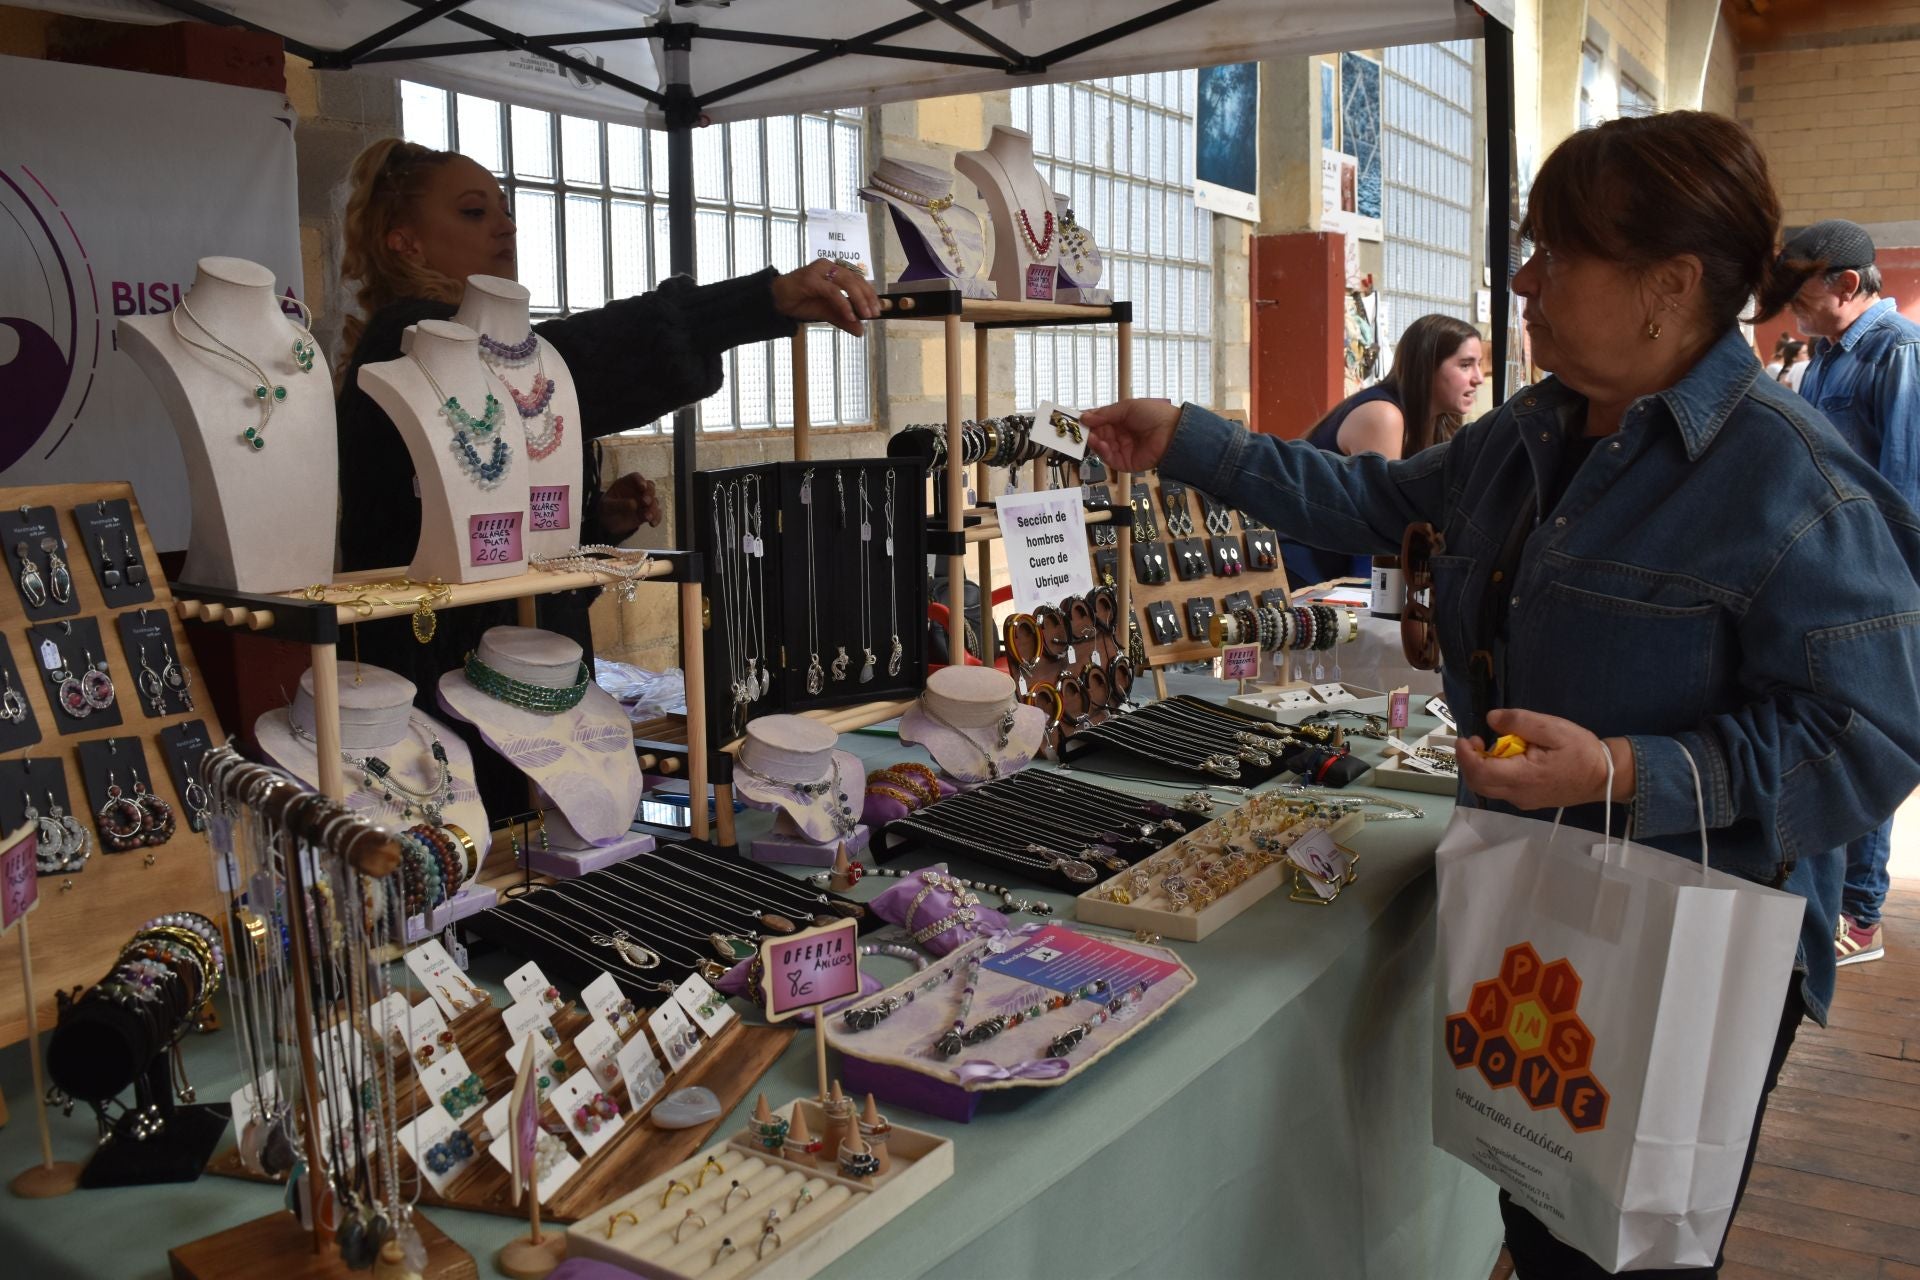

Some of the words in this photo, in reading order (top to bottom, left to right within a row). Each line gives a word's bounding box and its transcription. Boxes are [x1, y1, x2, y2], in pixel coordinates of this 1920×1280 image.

[828, 231, 846, 241] MIEL
[817, 249, 837, 259] GRAN
[839, 251, 860, 260] DUJO
[530, 491, 563, 502] OFERTA
[533, 511, 555, 519] PLATA
[1016, 512, 1053, 528] Sección
[1055, 510, 1067, 523] de
[477, 518, 515, 532] OFERTA
[534, 518, 560, 529] 20€
[471, 529, 511, 540] COLLARES
[1025, 533, 1065, 548] hombres
[483, 538, 510, 547] PLATA
[475, 548, 510, 562] 20€
[1029, 556, 1056, 569] Cuero
[1057, 552, 1069, 563] de
[1034, 573, 1070, 589] Ubrique
[783, 937, 842, 965] OFERTA
[1514, 1011, 1541, 1039] IN
[1453, 1023, 1597, 1118] LOVE
[1455, 1087, 1512, 1129] APICULTURA
[1513, 1122, 1573, 1163] ECOLÓGICA
